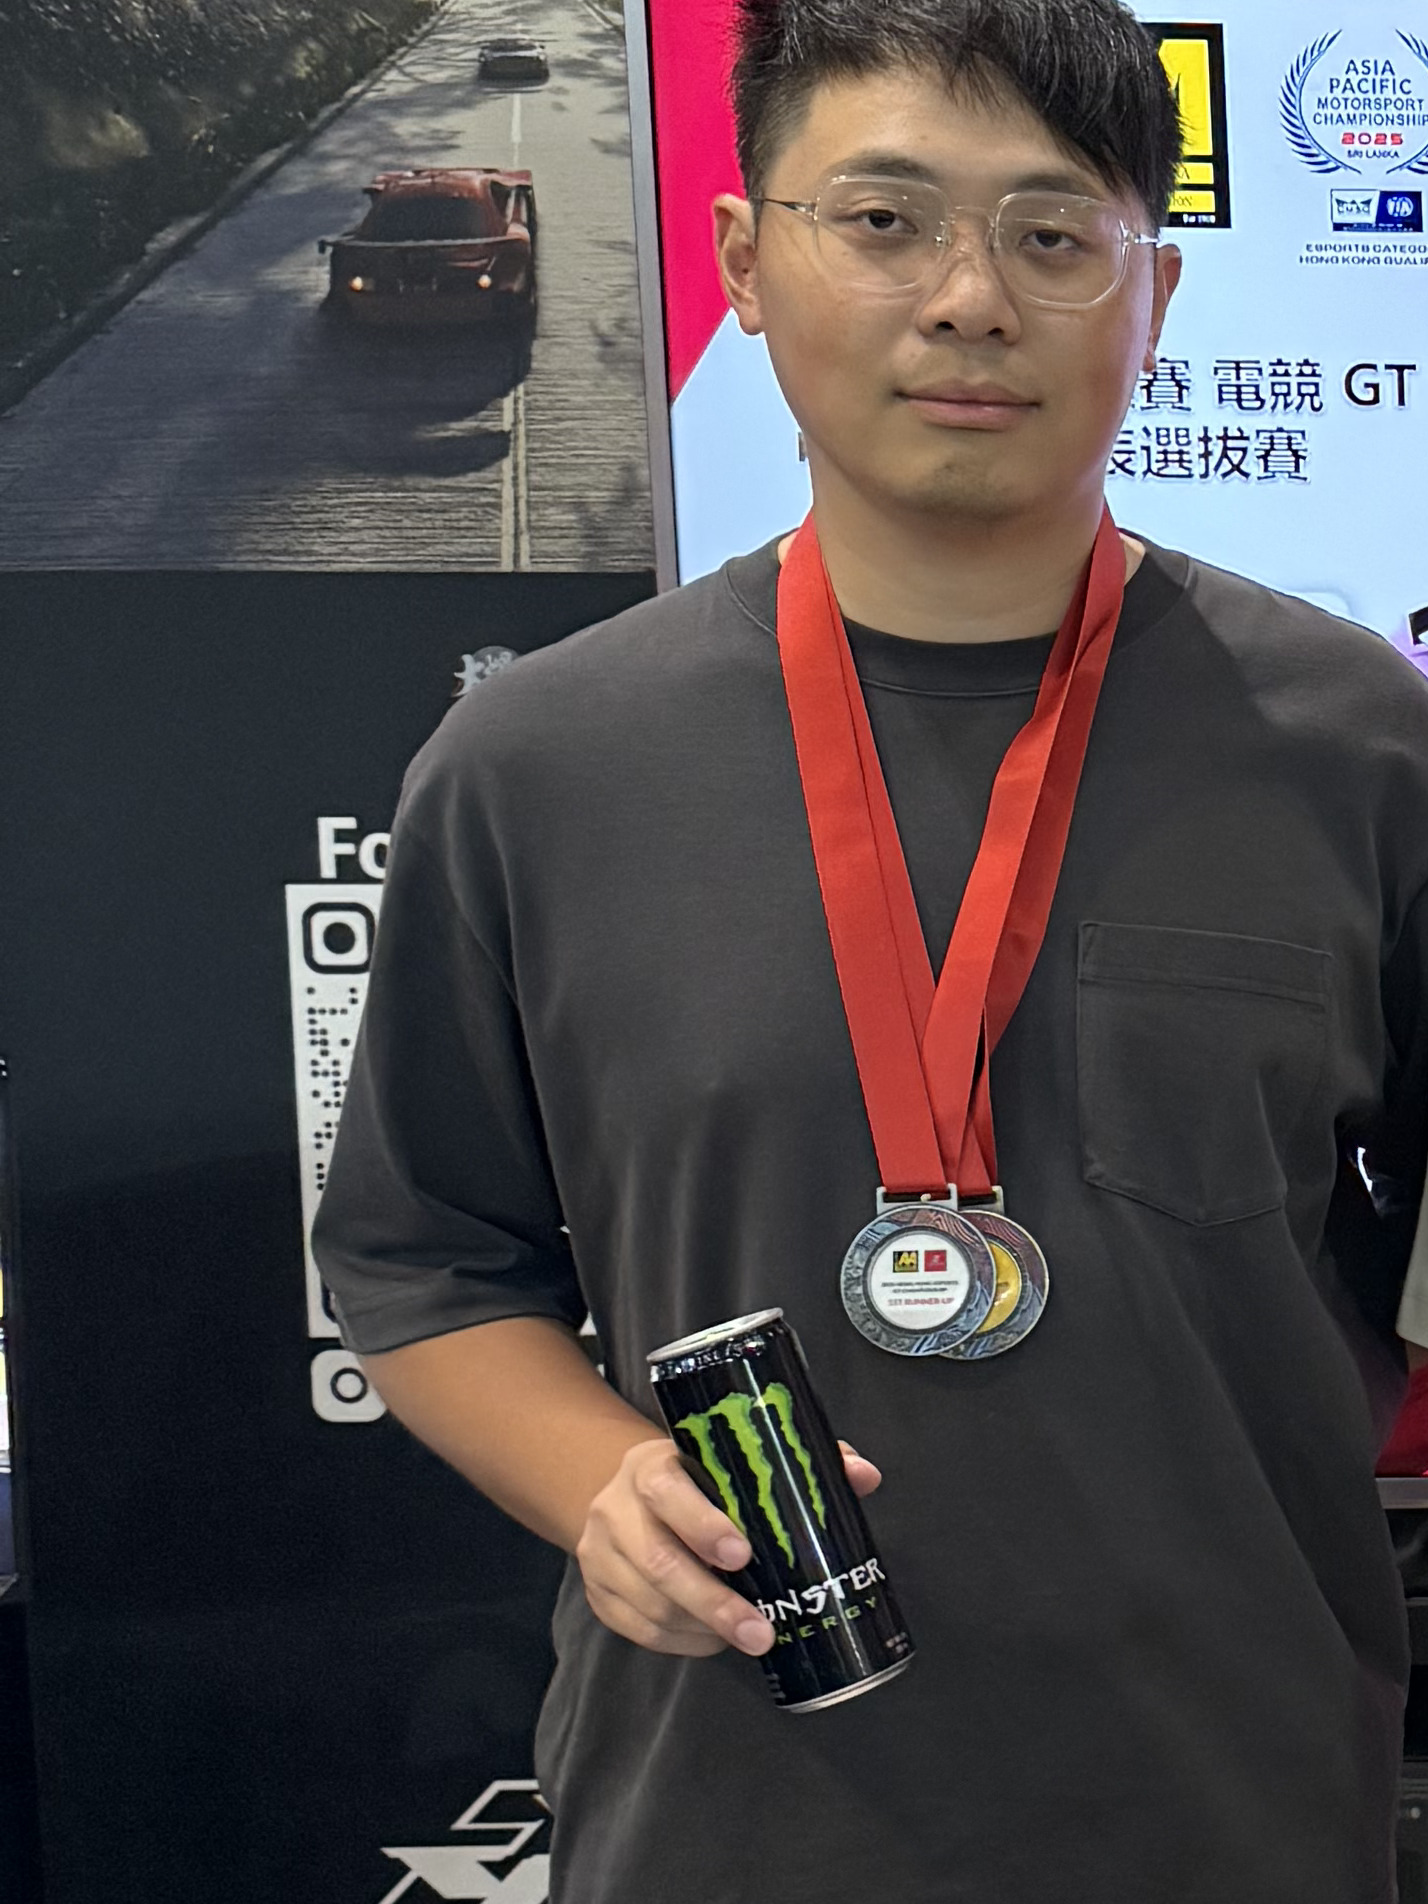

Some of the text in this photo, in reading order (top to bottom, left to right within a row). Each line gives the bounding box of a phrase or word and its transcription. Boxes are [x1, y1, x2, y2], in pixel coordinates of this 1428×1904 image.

[1345, 59, 1396, 76] ASIA
[1329, 78, 1413, 95] PACIFIC
[1317, 97, 1425, 112] MOTORSPORT
[1341, 132, 1404, 145] 2025
[1130, 358, 1192, 412] 賽
[1343, 362, 1417, 407] GT
[757, 1557, 886, 1623] ONSTER
[777, 1596, 877, 1645] NERGY
